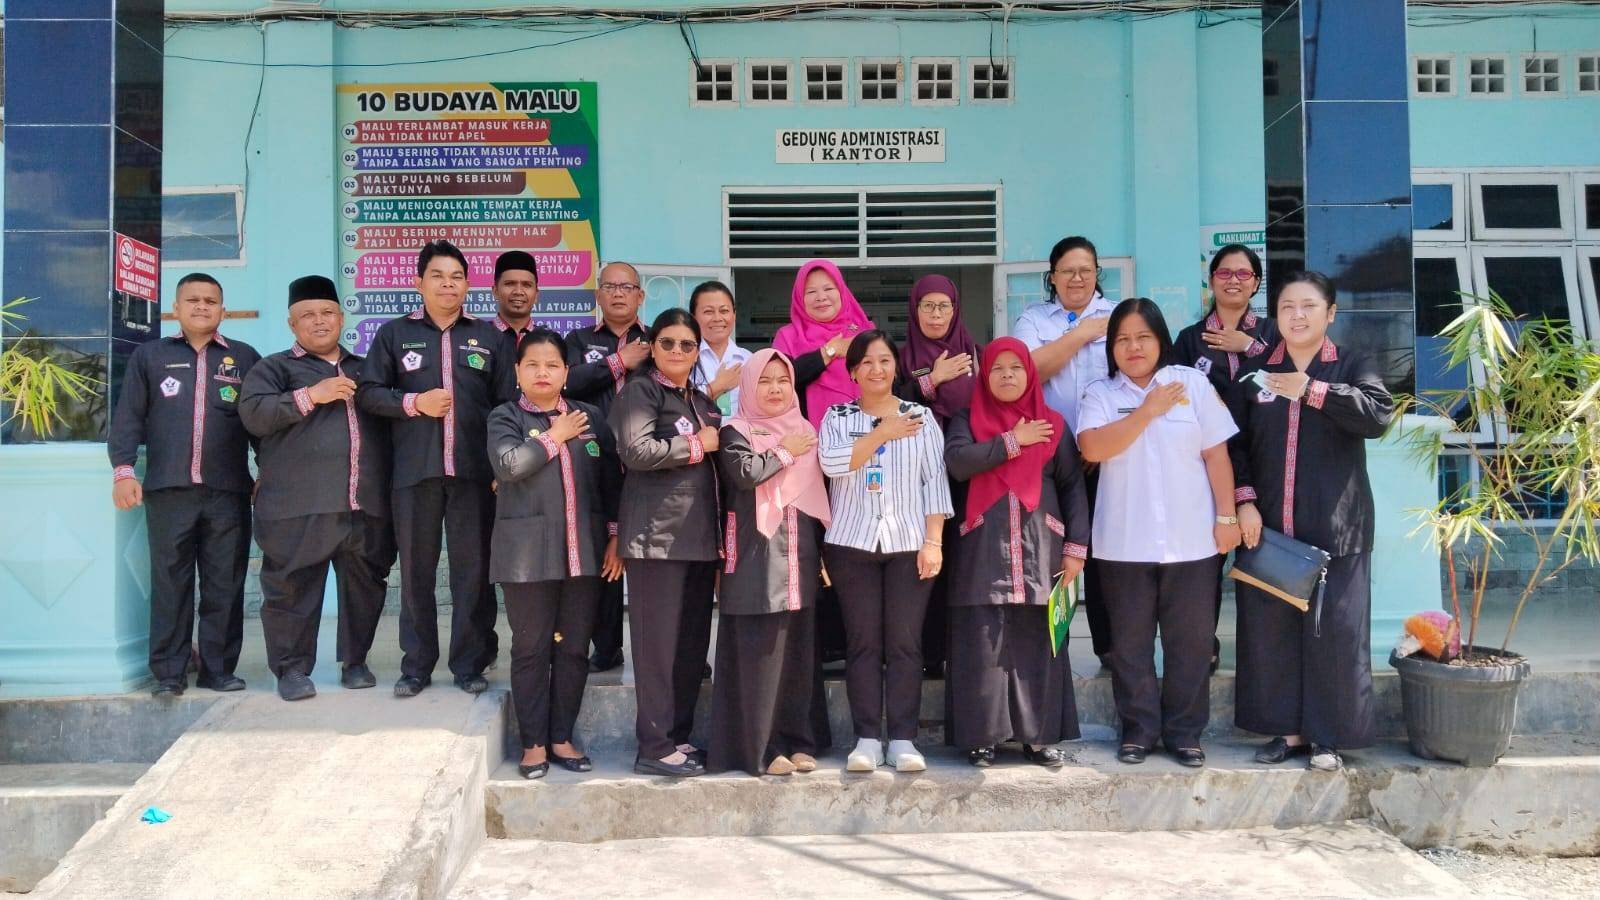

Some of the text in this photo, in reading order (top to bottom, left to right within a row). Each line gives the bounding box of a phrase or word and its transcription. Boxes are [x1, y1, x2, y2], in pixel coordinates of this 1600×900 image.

[357, 90, 578, 112] 10 BUDAYA MALU
[361, 121, 548, 131] MALU TERLAMBAT MASUK KERJA
[345, 128, 355, 136] 01
[361, 131, 486, 141] DAN TIDAK IKUT APEL
[782, 130, 940, 146] GEDUNG ADMINISTRASI
[362, 146, 559, 157] MALU SERING TIDAK MASUK KERJA
[822, 148, 901, 160] KANTOR
[344, 154, 356, 162] 02
[362, 156, 582, 168] TANPA ALASAN YANG SANGAT PENTING
[362, 174, 512, 184] MALU PULANG SEBELUM
[344, 181, 355, 189] 03
[363, 185, 431, 194] WAKTUNYA
[363, 200, 562, 211] MALU MENIGGALKAN TEMPAT KERJA
[363, 210, 579, 221] TANPA ALASAN YANG SANGAT PENTING
[363, 227, 548, 237] MALU SERING MENUNTUT HAK
[345, 234, 356, 242] 05
[363, 238, 502, 248] TAPI LUPA KWAJIBAN
[363, 256, 395, 265] MALU
[344, 266, 355, 274] 06
[363, 266, 387, 275] DAN
[346, 299, 357, 307] 07
[364, 294, 396, 303] MALU
[364, 304, 399, 313] TIDAK
[546, 303, 591, 312] ATURAN
[566, 320, 586, 330] RS.
[346, 333, 357, 341] 08
